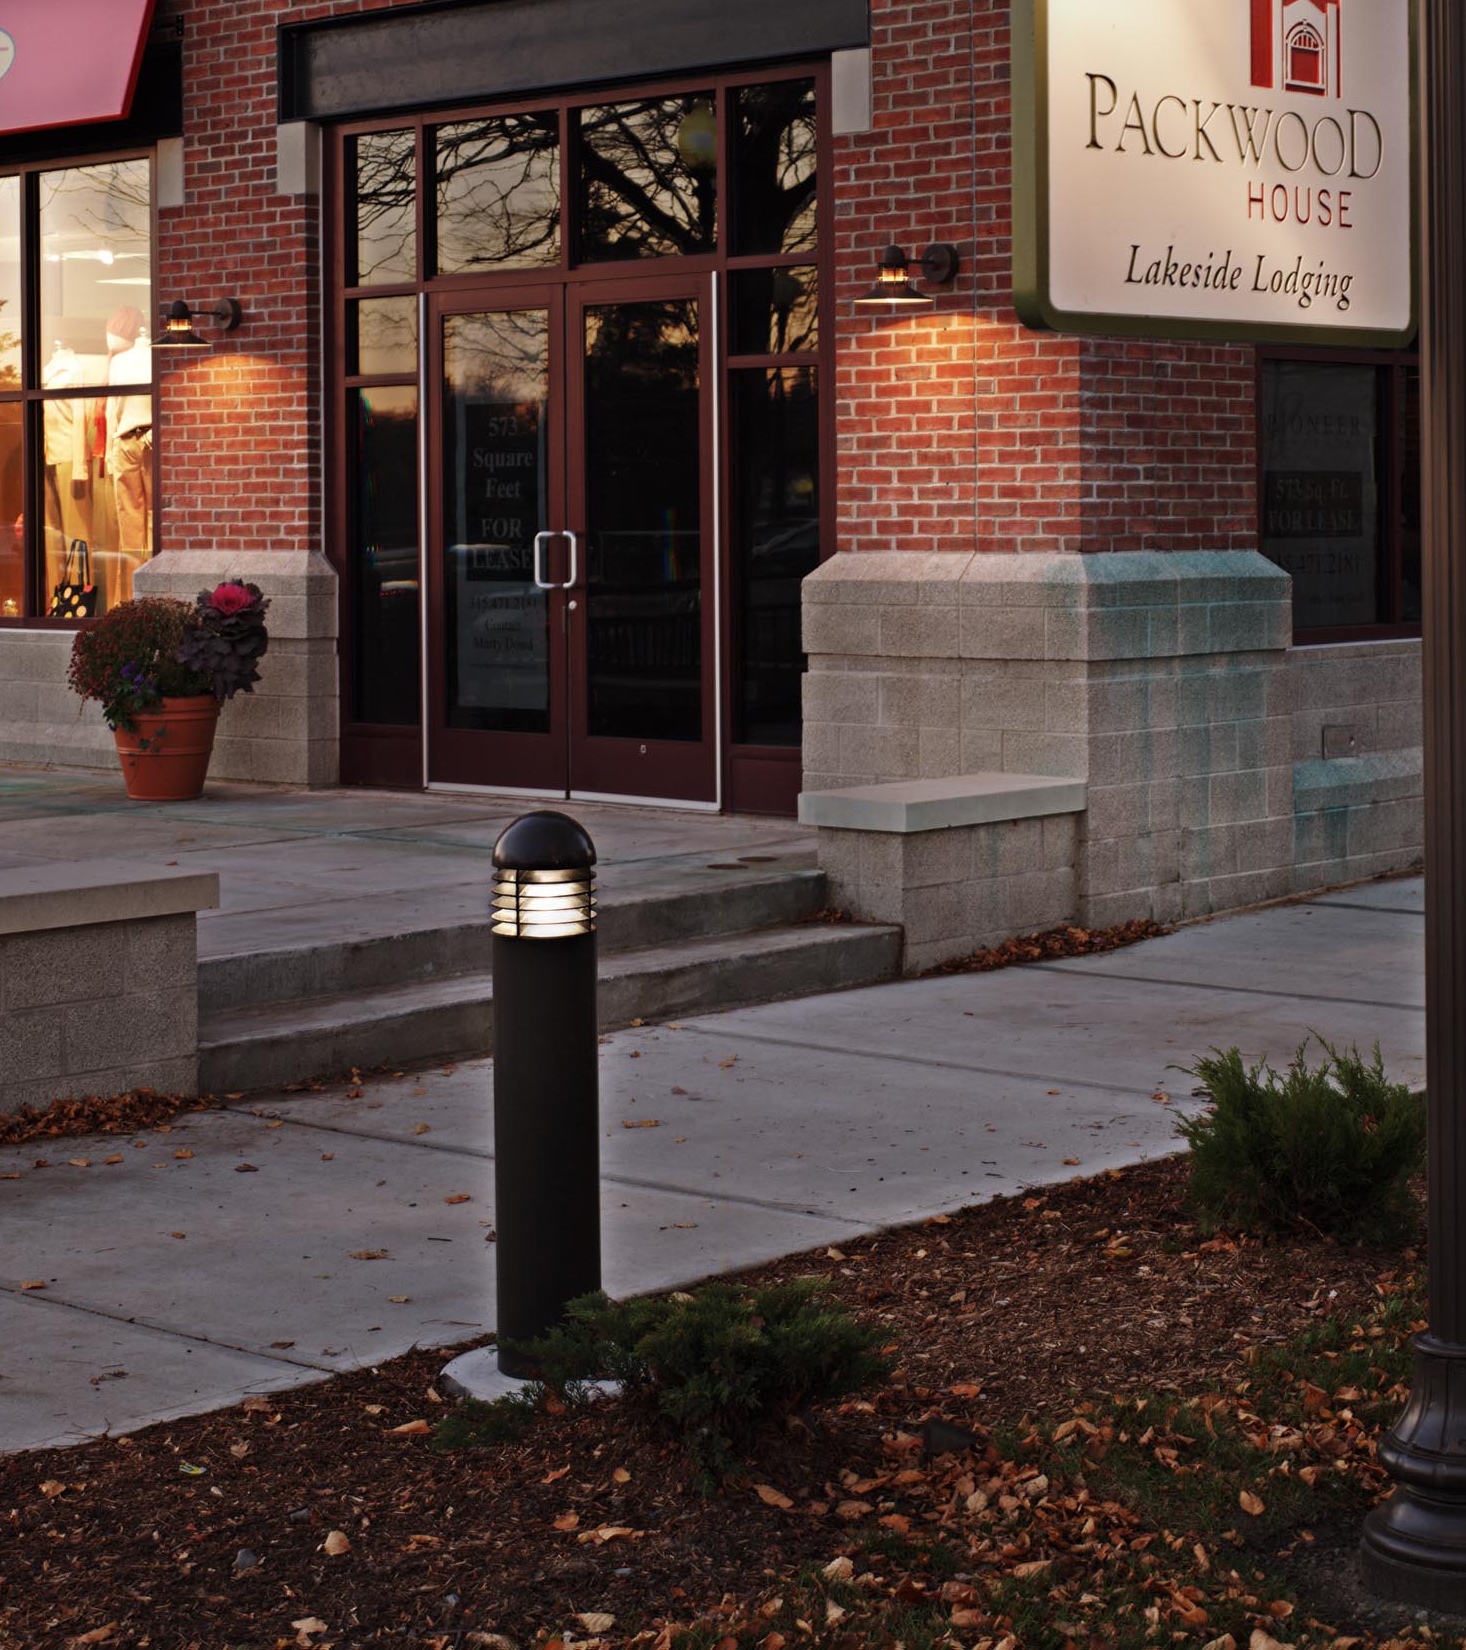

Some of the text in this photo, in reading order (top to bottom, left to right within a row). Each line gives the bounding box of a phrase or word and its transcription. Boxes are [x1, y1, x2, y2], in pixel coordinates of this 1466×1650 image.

[1085, 72, 1382, 179] PACKWOOD
[1248, 181, 1353, 228] HOUSE
[1125, 244, 1353, 310] Lakeside Lodging
[487, 416, 518, 438] 573
[472, 447, 533, 473] Square
[484, 478, 522, 499] Feet
[481, 518, 523, 539] FOR
[1268, 510, 1358, 532] FOR LEASE
[471, 549, 533, 570] LEASE
